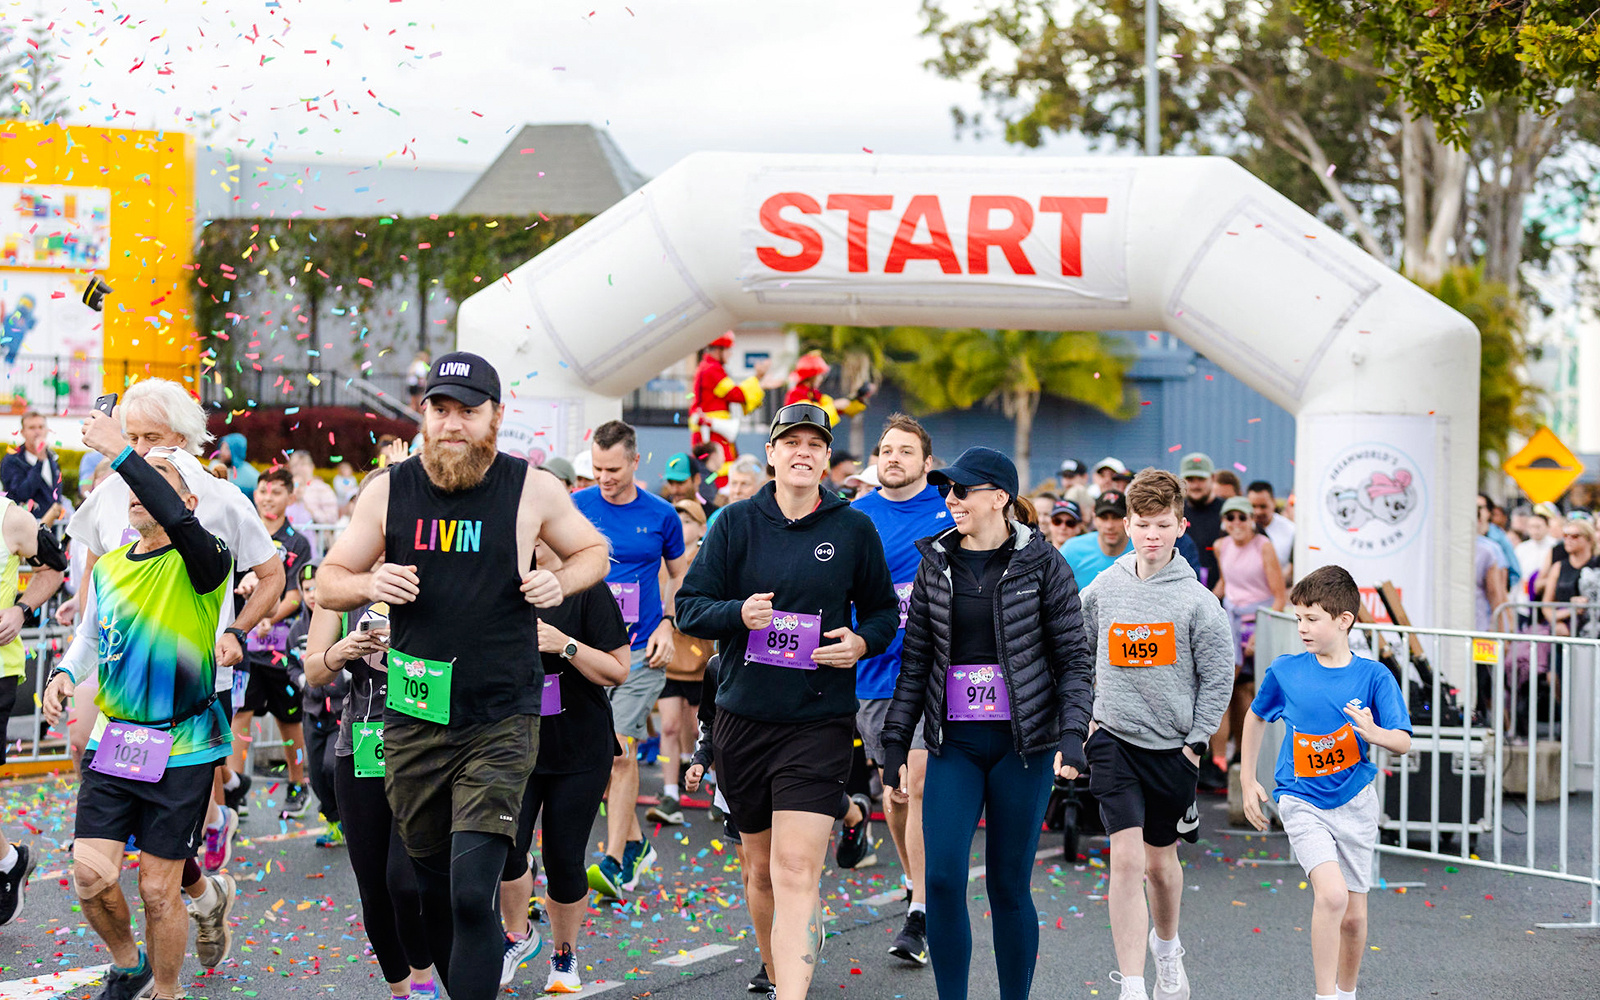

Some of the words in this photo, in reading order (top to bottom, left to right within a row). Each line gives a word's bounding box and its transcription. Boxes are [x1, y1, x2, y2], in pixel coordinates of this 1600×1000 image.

[756, 192, 1108, 277] START
[439, 362, 470, 376] LIVIN
[414, 518, 482, 552] LIVIN
[1350, 538, 1374, 550] FUN
[1380, 530, 1404, 546] RUN
[767, 630, 799, 651] 895
[1122, 642, 1158, 658] 1459
[402, 677, 428, 700] 709
[967, 686, 996, 703] 974
[114, 744, 149, 766] 1021
[375, 743, 384, 760] 6
[1308, 749, 1345, 768] 1343
